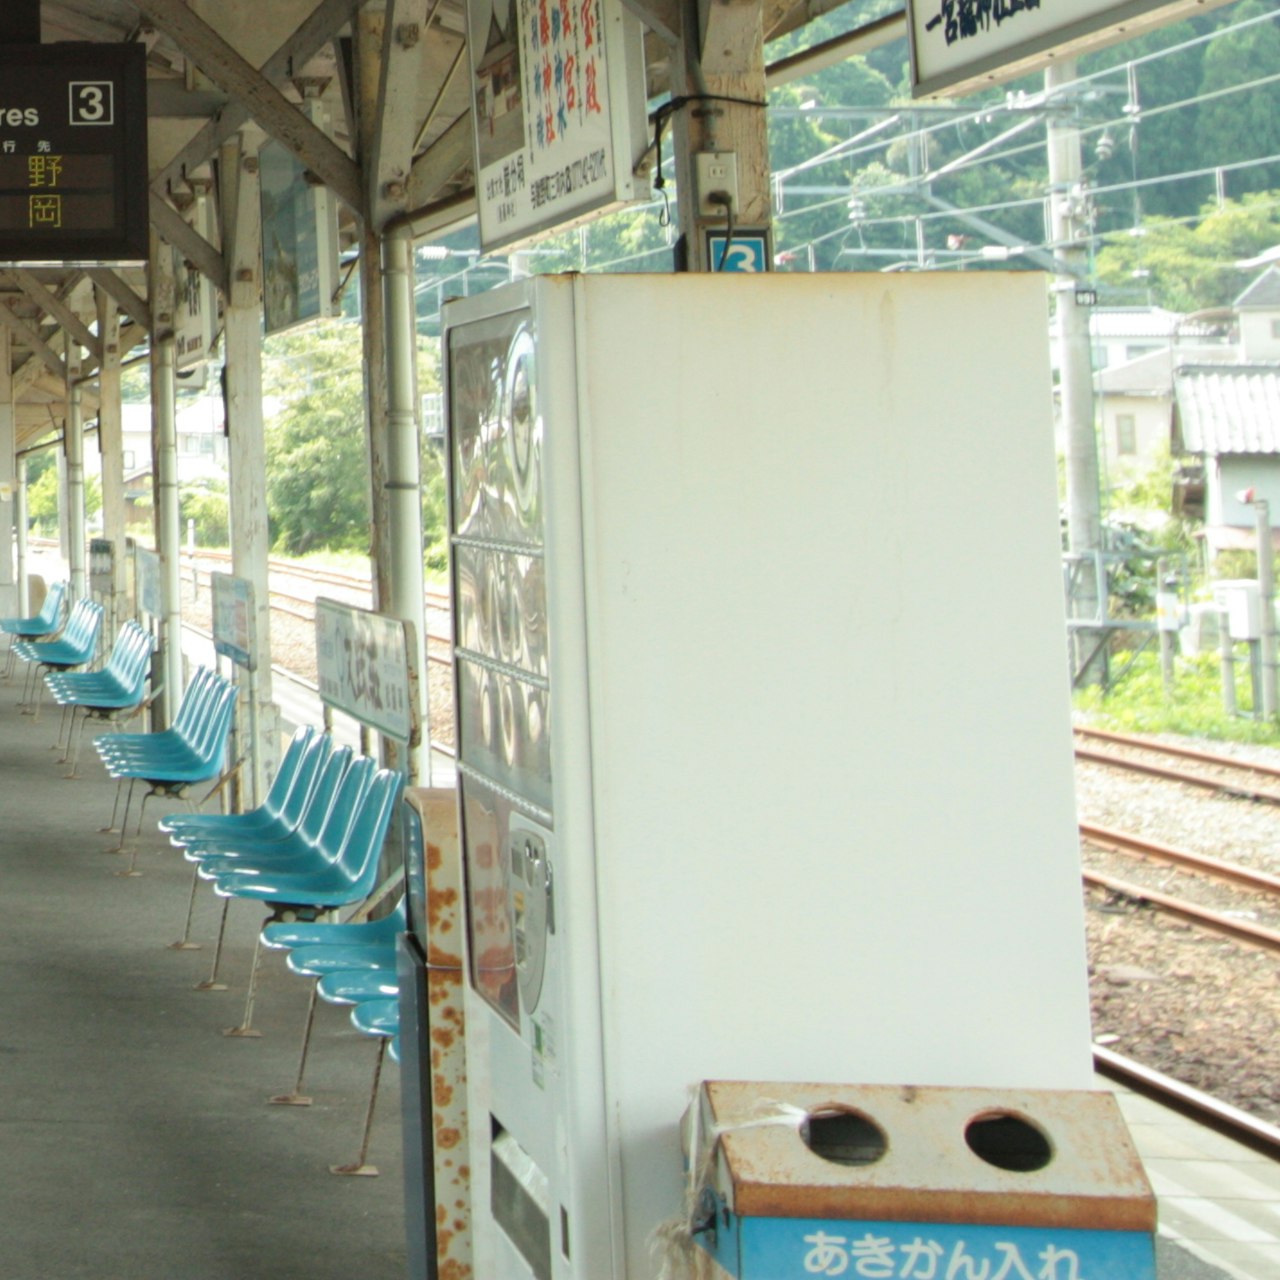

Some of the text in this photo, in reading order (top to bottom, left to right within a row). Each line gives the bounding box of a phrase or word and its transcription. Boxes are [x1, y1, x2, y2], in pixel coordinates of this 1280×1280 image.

[78, 86, 105, 121] 3
[803, 1231, 1082, 1280] あきかん入れ
